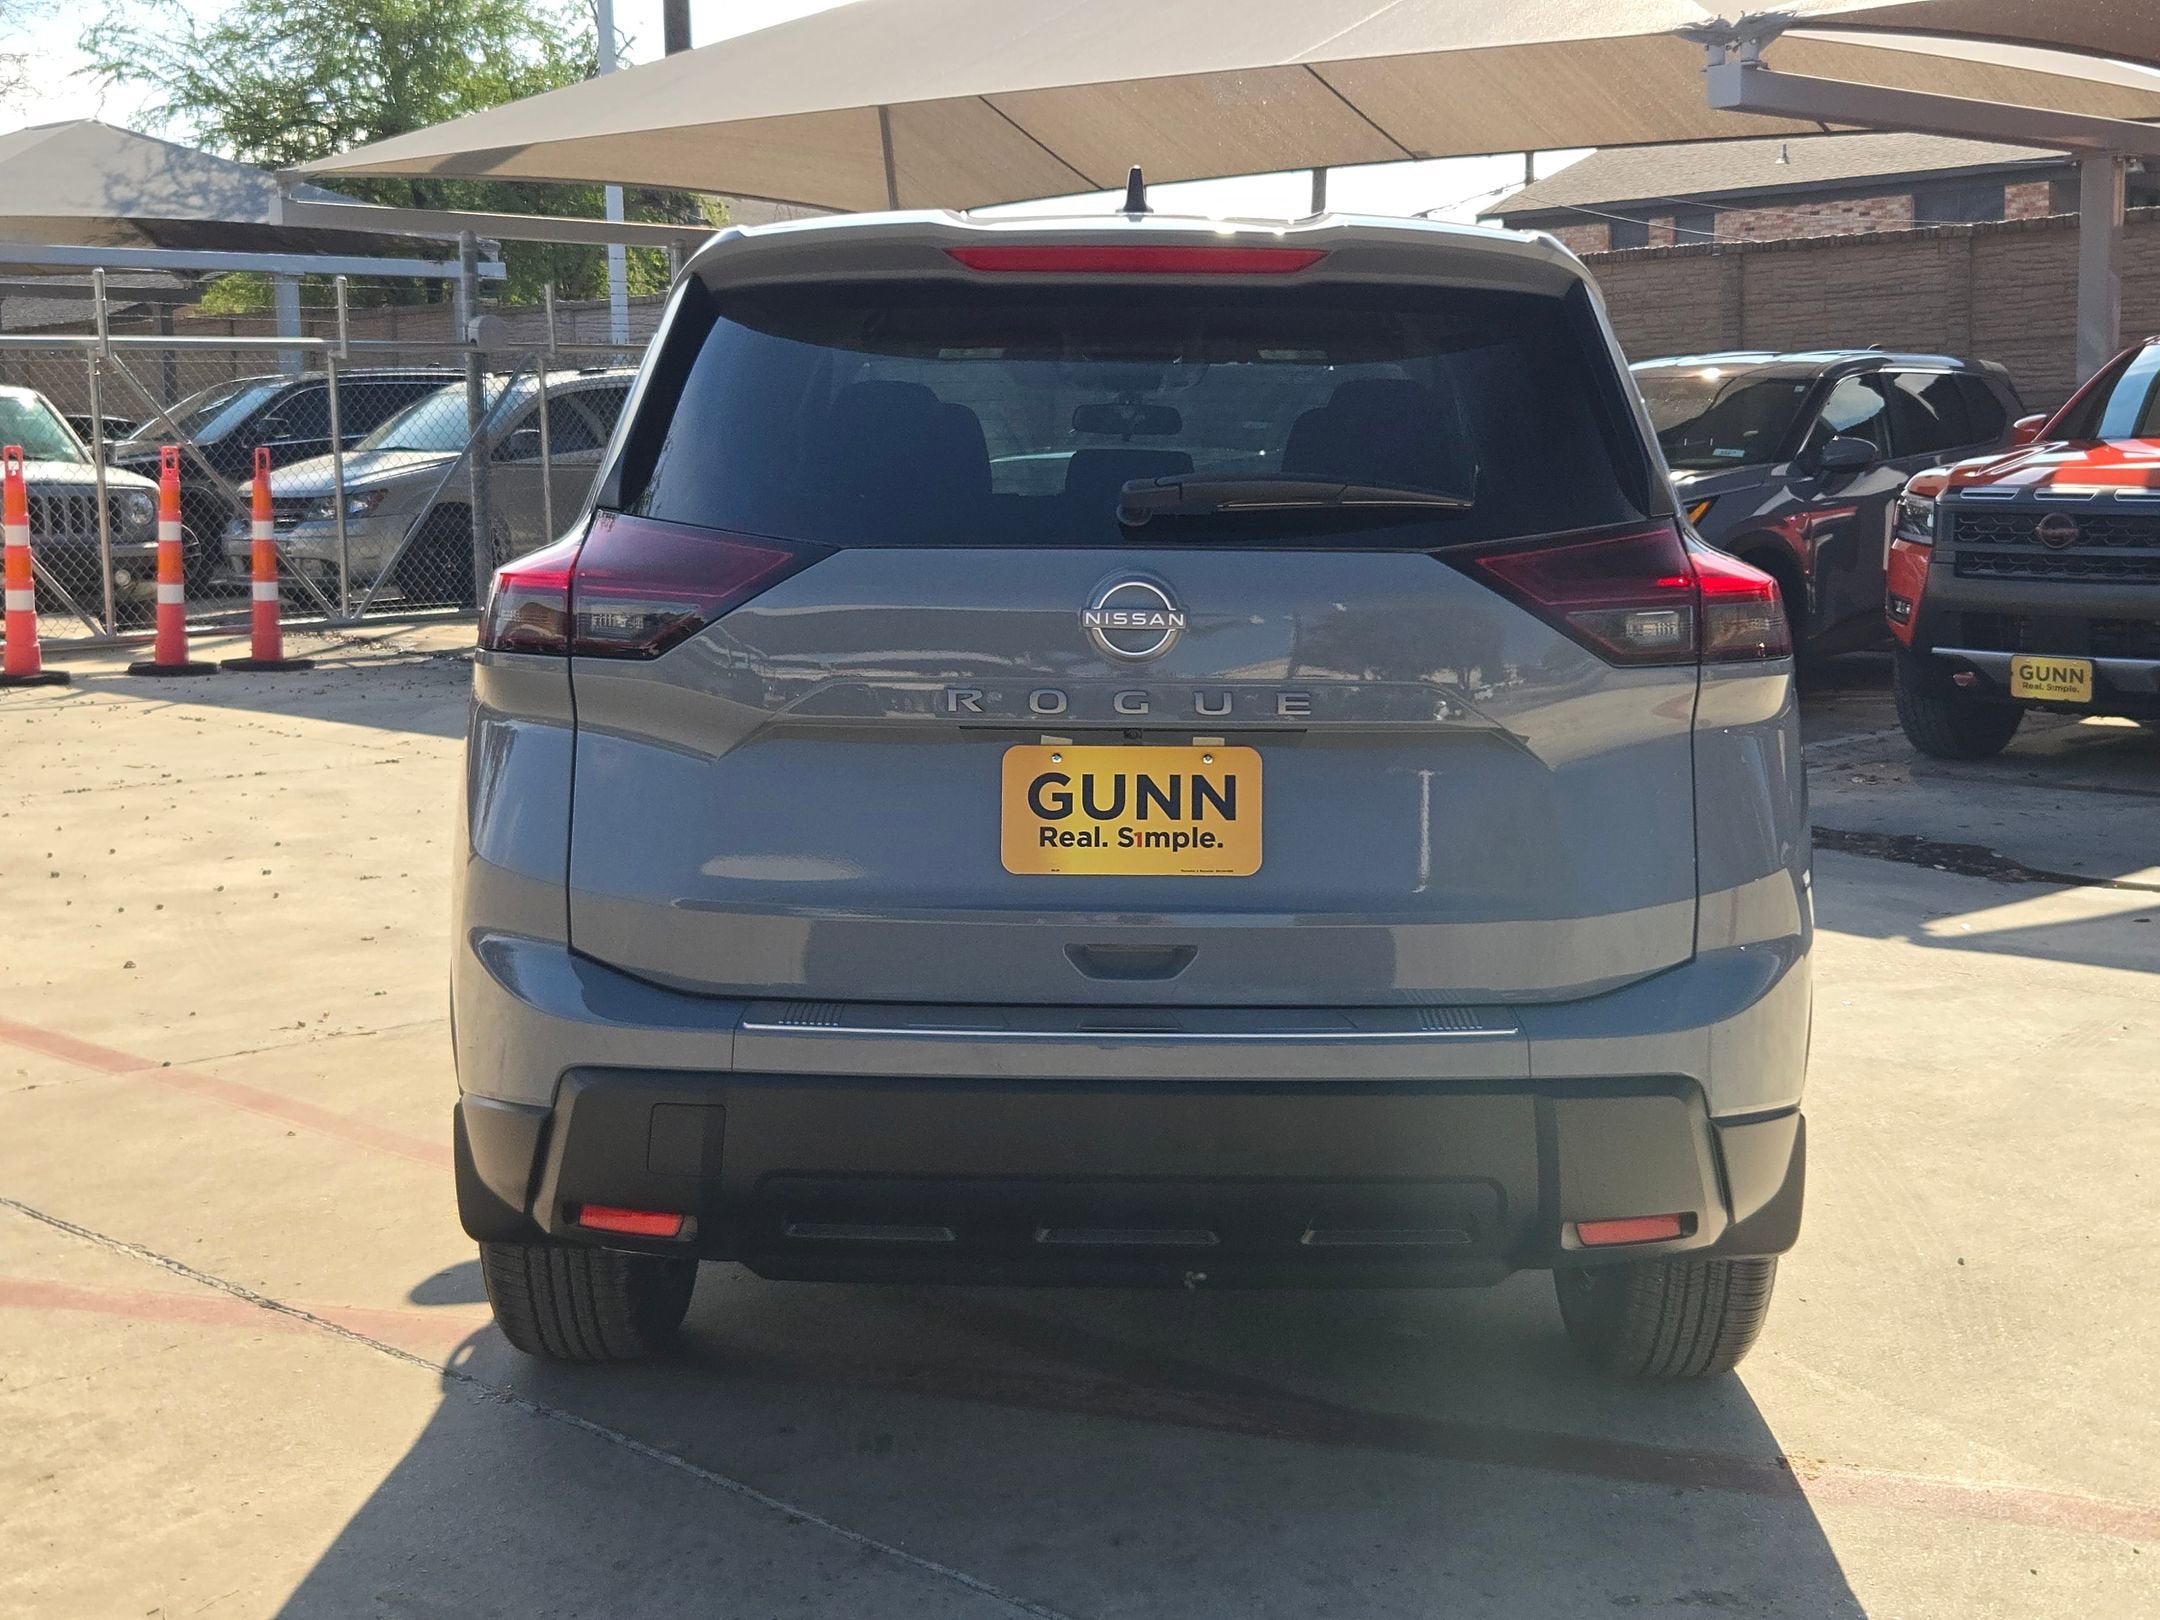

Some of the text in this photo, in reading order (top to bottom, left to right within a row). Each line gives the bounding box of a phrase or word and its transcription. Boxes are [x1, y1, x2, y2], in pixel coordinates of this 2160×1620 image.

[1085, 612, 1184, 626] NISSAN
[2020, 665, 2084, 684] GUNN
[946, 689, 1313, 716] ROGUE
[1027, 772, 1237, 821] GUNN
[1039, 826, 1108, 848] Real.
